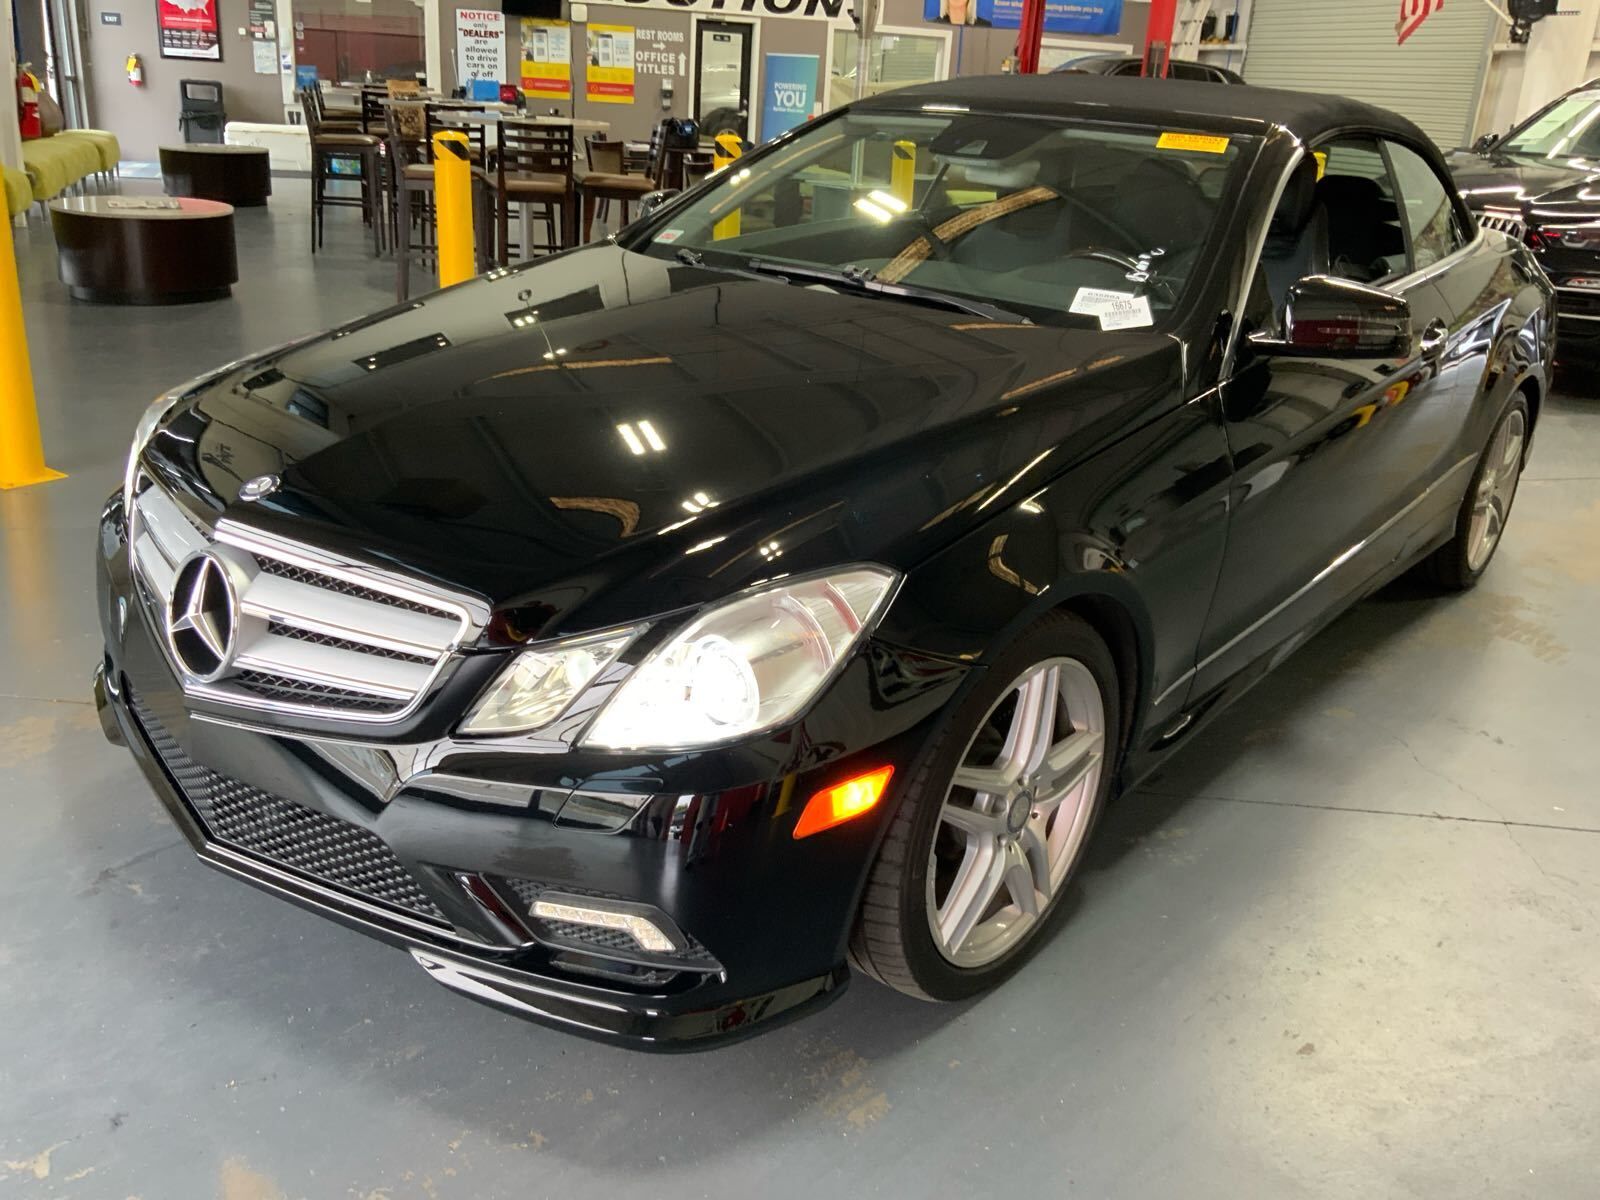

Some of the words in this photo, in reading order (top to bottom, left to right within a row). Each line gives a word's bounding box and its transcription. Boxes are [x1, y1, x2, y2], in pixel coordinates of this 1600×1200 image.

[460, 11, 501, 21] NOTICE
[636, 28, 656, 40] REST
[657, 30, 684, 42] ROOMS
[465, 46, 498, 54] allowed
[635, 50, 676, 64] OFFICE
[636, 62, 675, 75] TITLES
[774, 90, 807, 108] YOU
